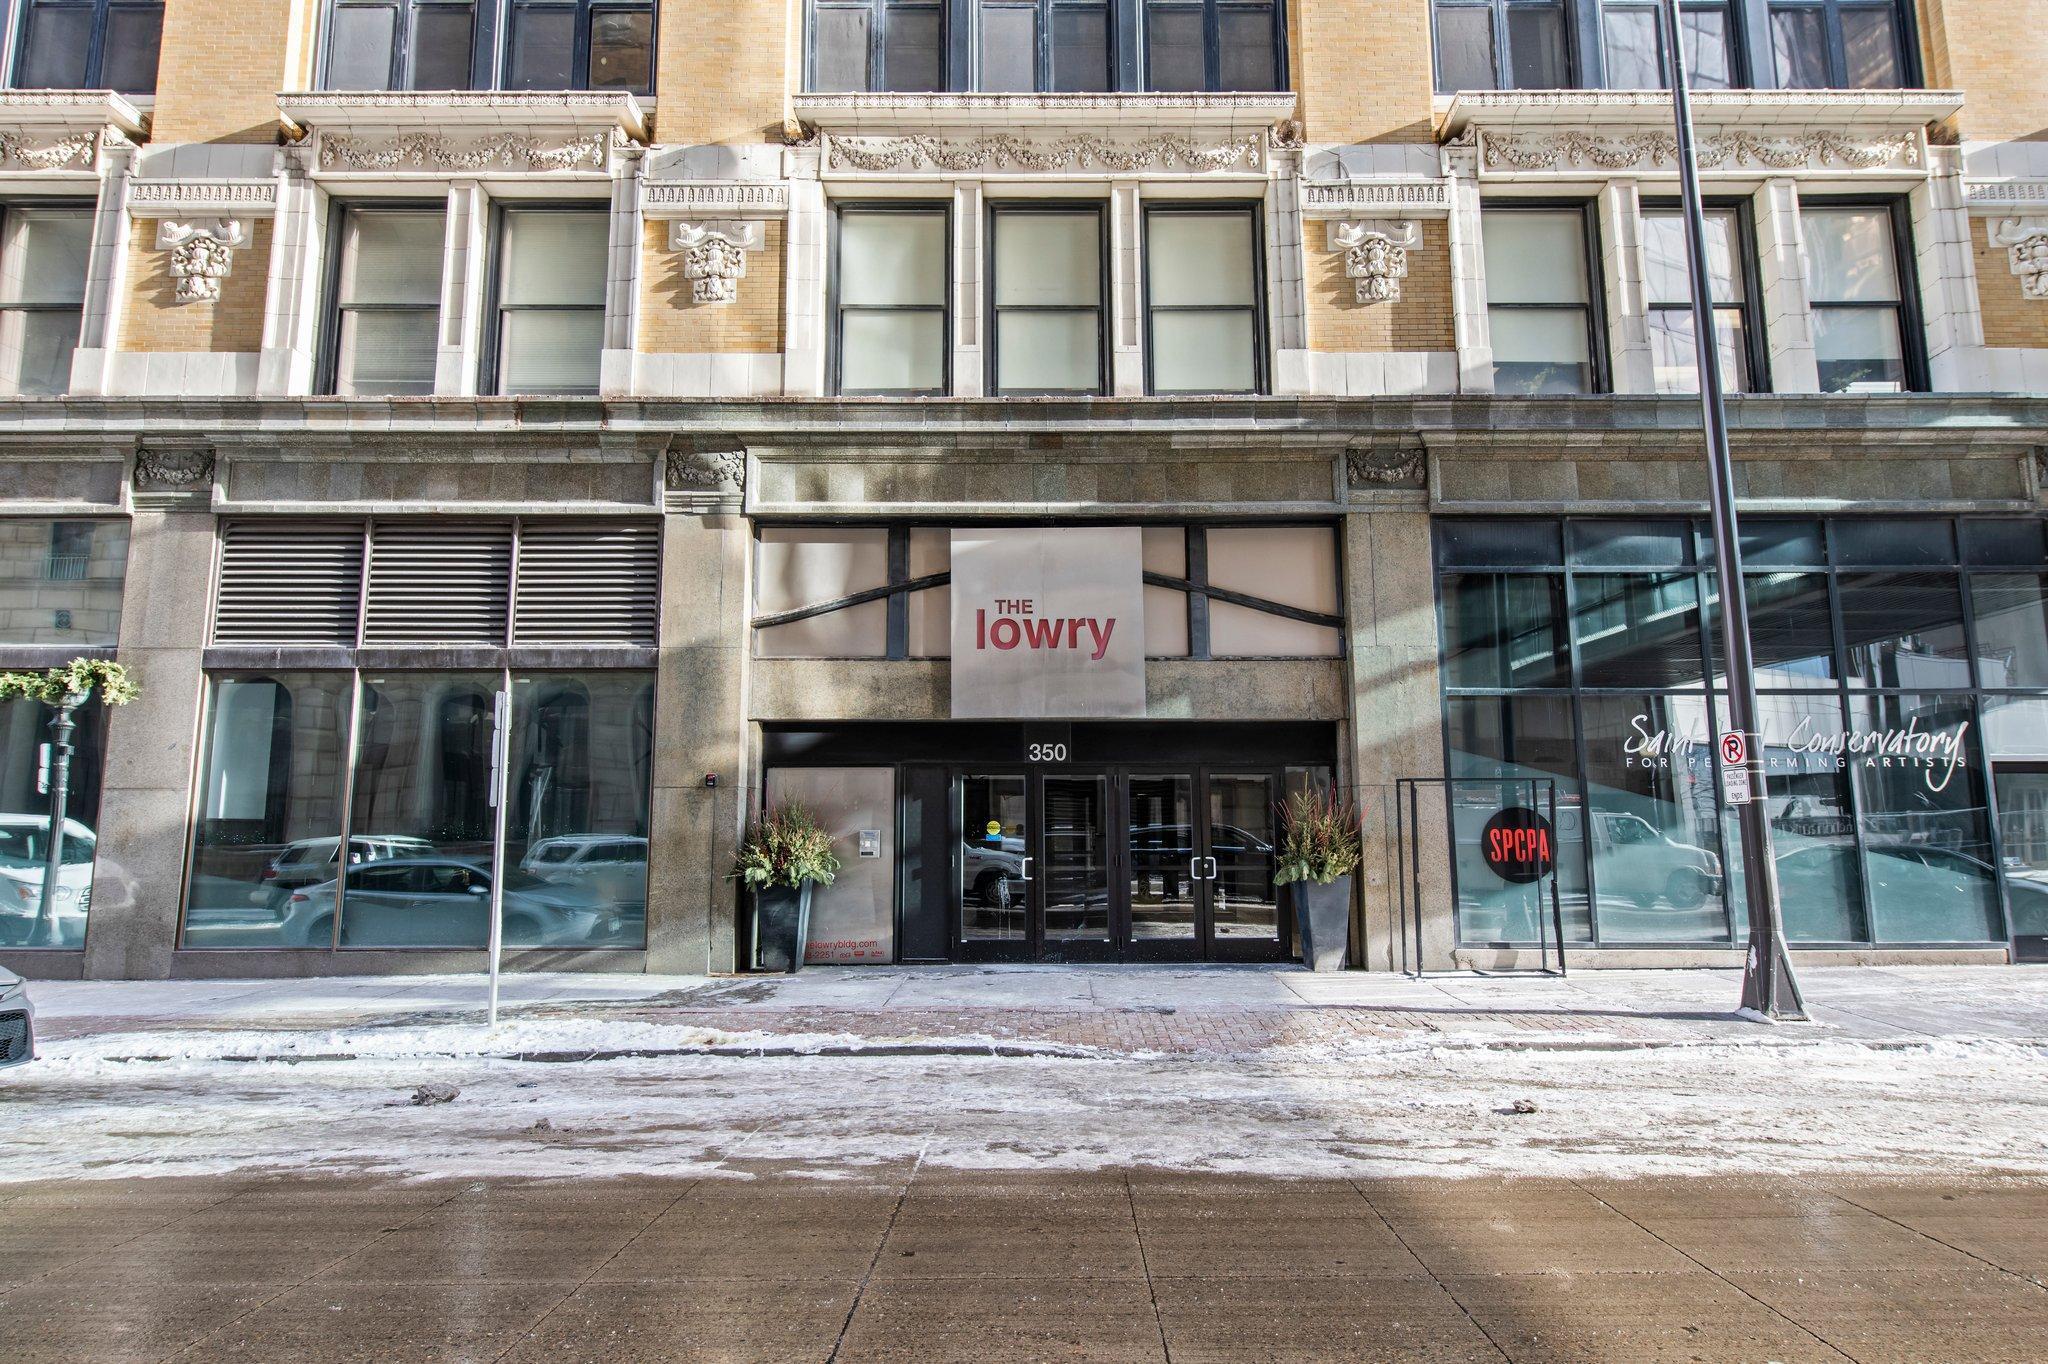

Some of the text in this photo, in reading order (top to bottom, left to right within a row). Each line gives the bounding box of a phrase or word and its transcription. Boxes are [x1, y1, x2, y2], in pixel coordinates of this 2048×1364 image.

[994, 599, 1034, 614] THE
[976, 609, 1117, 660] lowry
[1028, 743, 1067, 761] 350
[1626, 756, 1967, 768] FOR PERMING ARTISTS
[1786, 715, 1969, 792] Conservatory
[1489, 828, 1550, 862] SPCPA
